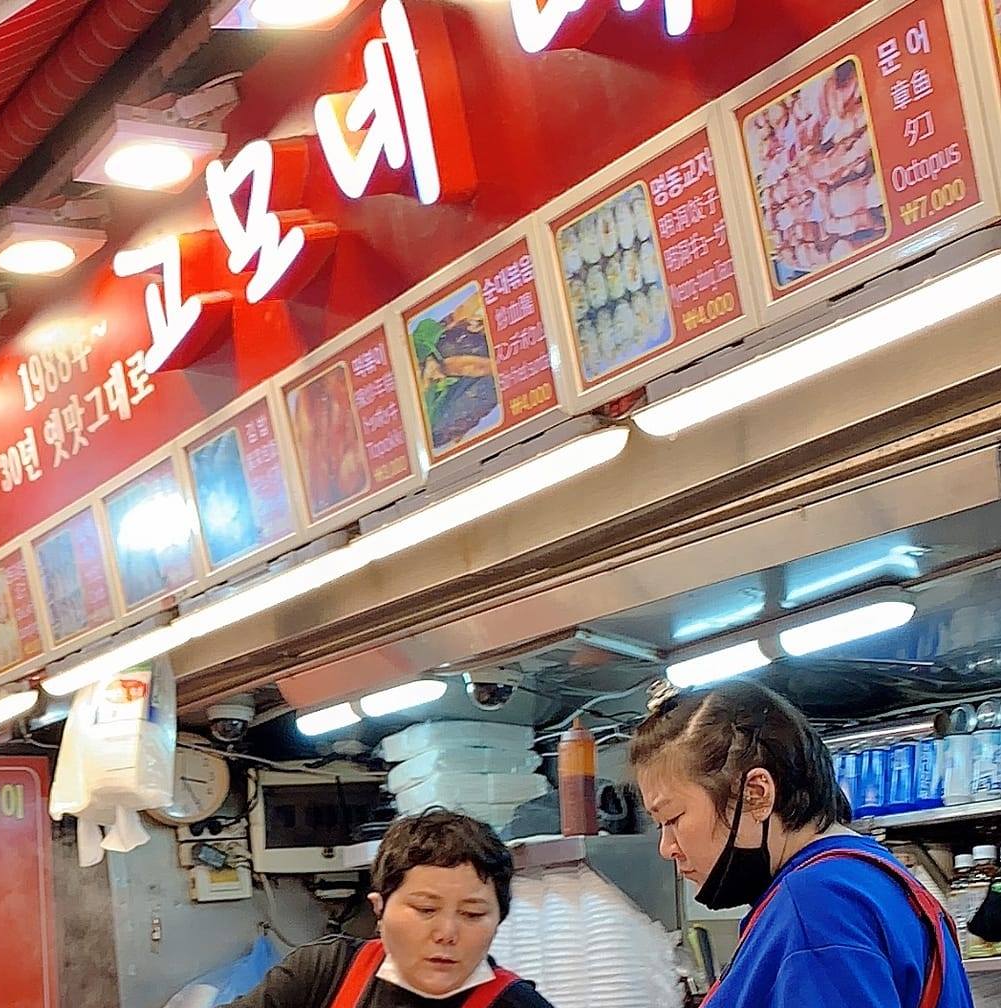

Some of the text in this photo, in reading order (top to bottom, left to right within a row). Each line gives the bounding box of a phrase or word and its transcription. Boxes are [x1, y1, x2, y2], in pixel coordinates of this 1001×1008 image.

[877, 20, 931, 77] 문어
[903, 111, 935, 147] タコ
[113, 0, 440, 373] 고모네
[649, 147, 715, 206] 명동교자
[891, 142, 962, 192] Octopus
